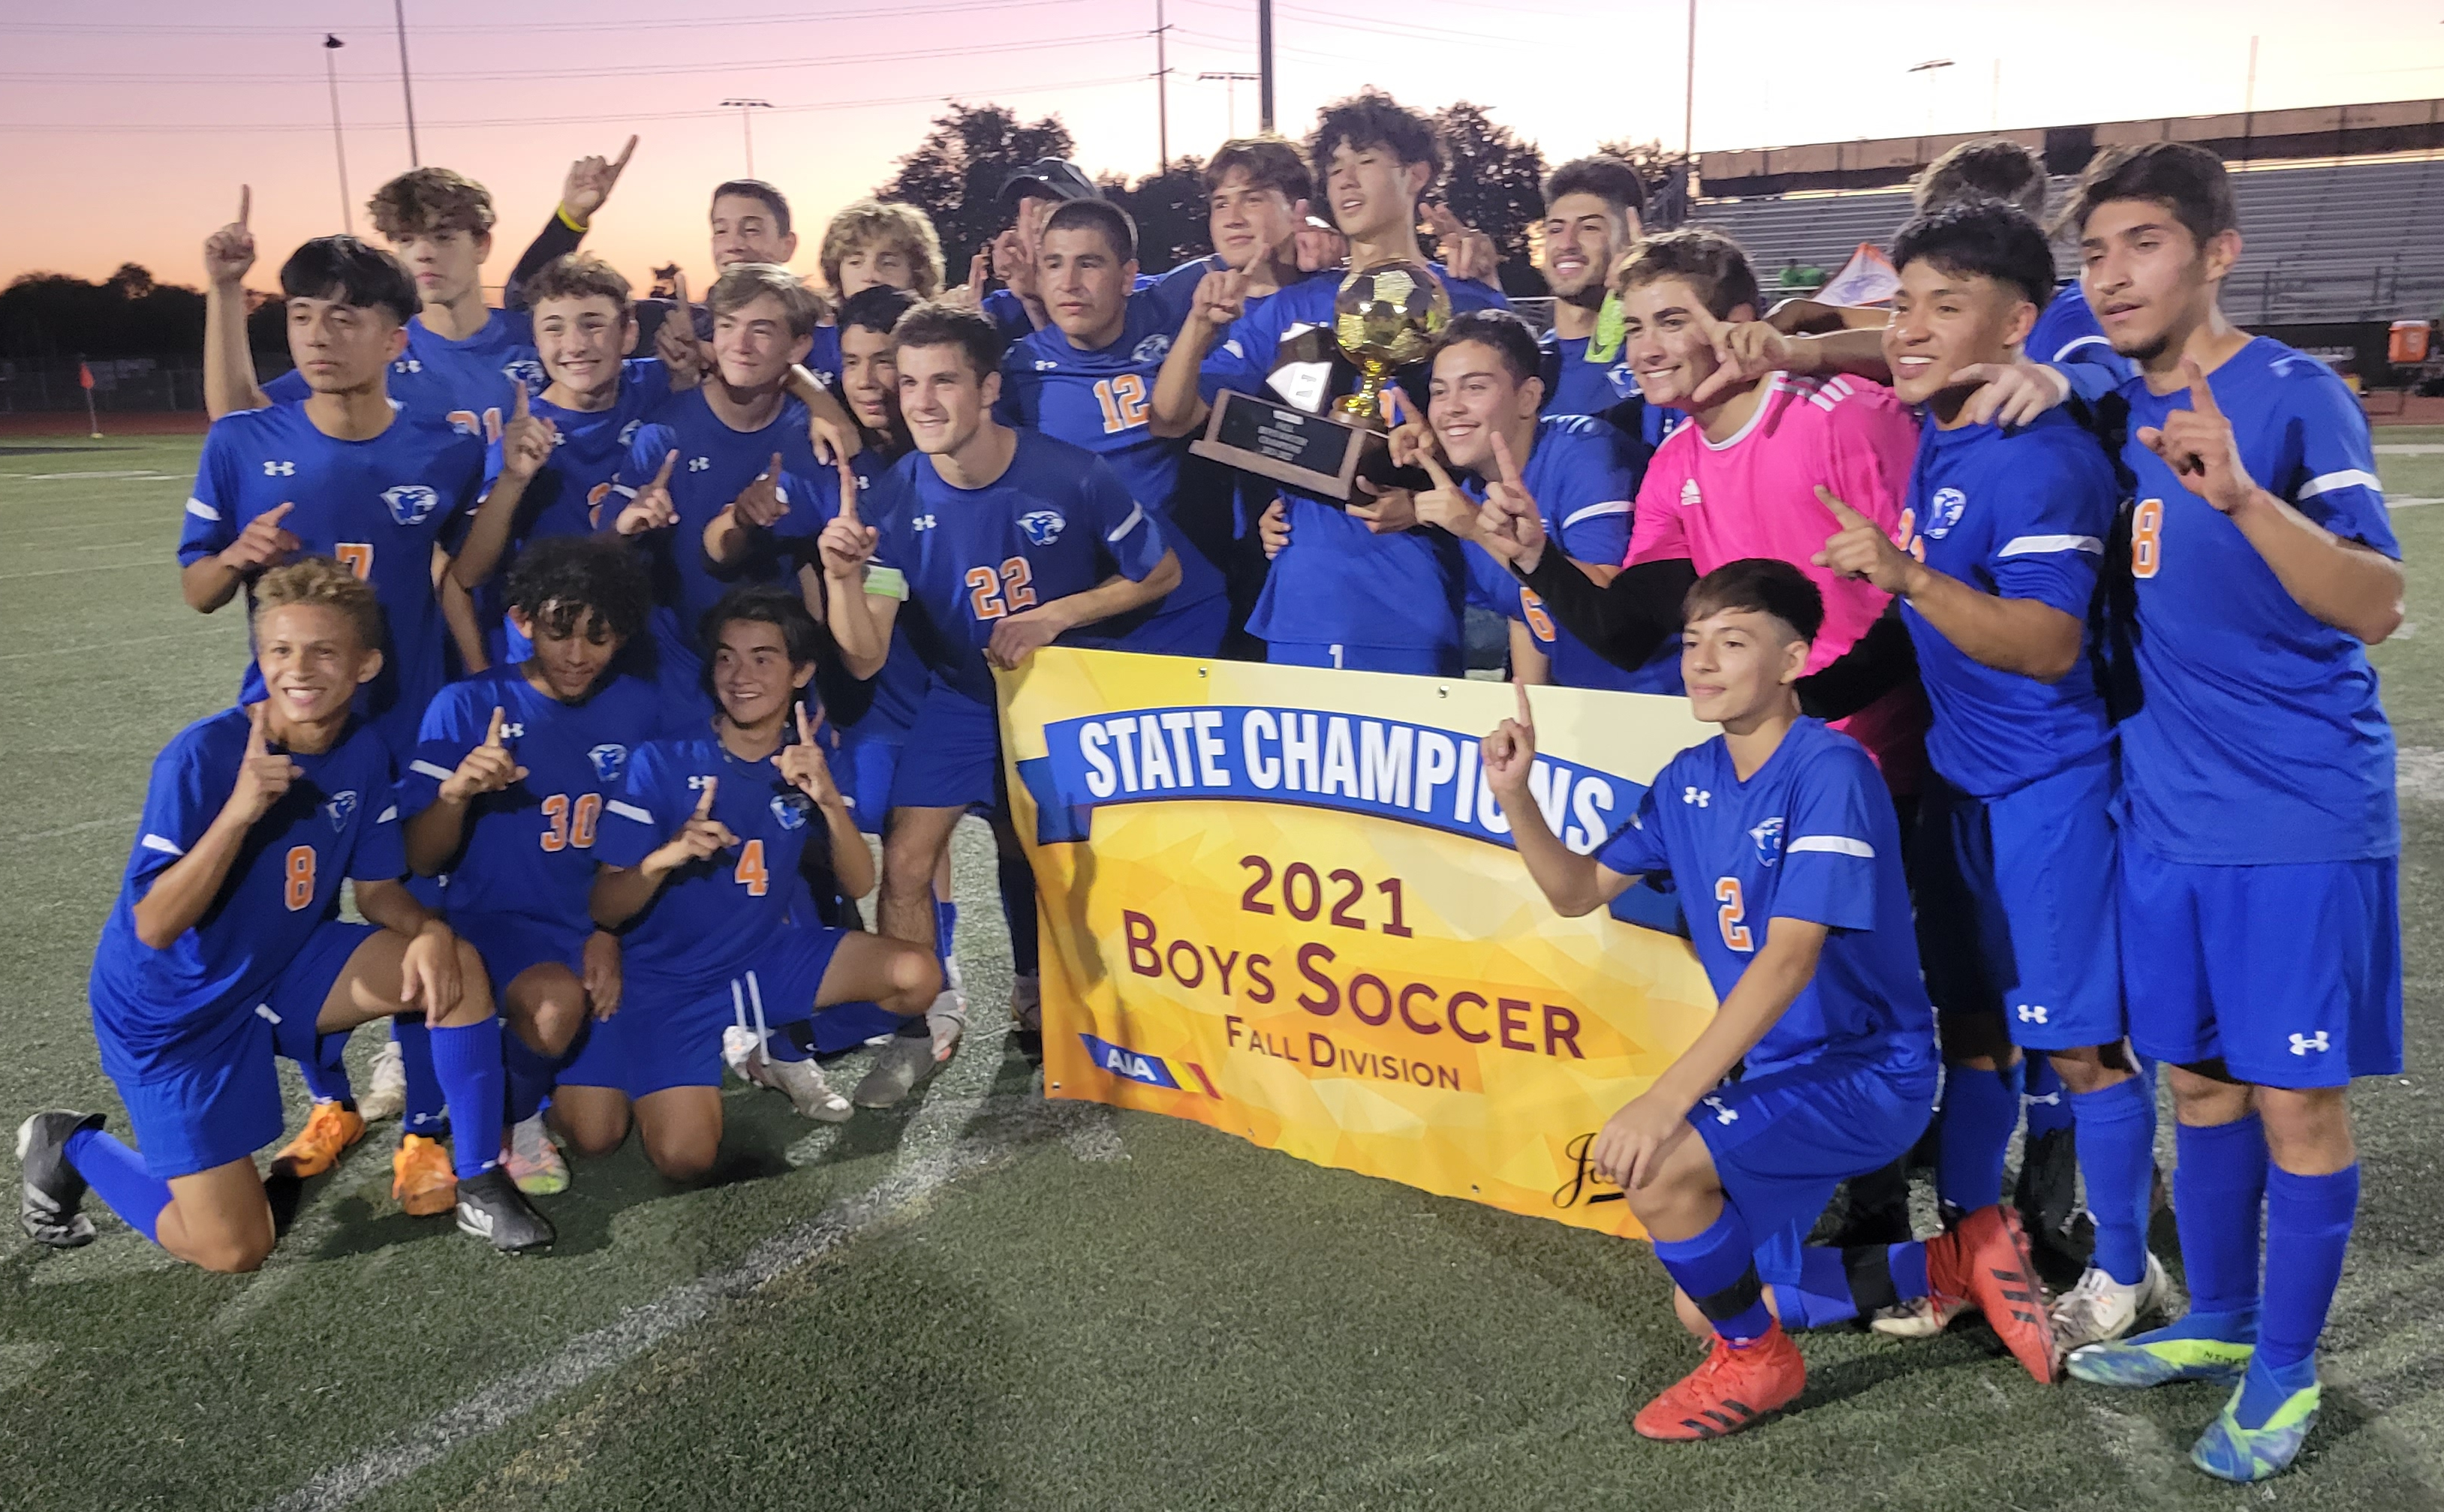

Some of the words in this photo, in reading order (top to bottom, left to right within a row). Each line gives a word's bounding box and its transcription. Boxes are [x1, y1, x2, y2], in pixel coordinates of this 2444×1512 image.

[1093, 374, 1151, 434] 12
[334, 543, 375, 581] 7
[2131, 498, 2165, 579] 8
[965, 557, 1037, 621] 22
[1519, 586, 1556, 642] 6
[1079, 711, 1232, 798] STATE
[540, 793, 603, 852] 30
[284, 845, 317, 912] 8
[734, 839, 769, 897] 4
[1238, 855, 1413, 939] 2021
[1714, 876, 1754, 951] 2
[1106, 1048, 1158, 1081] AIA
